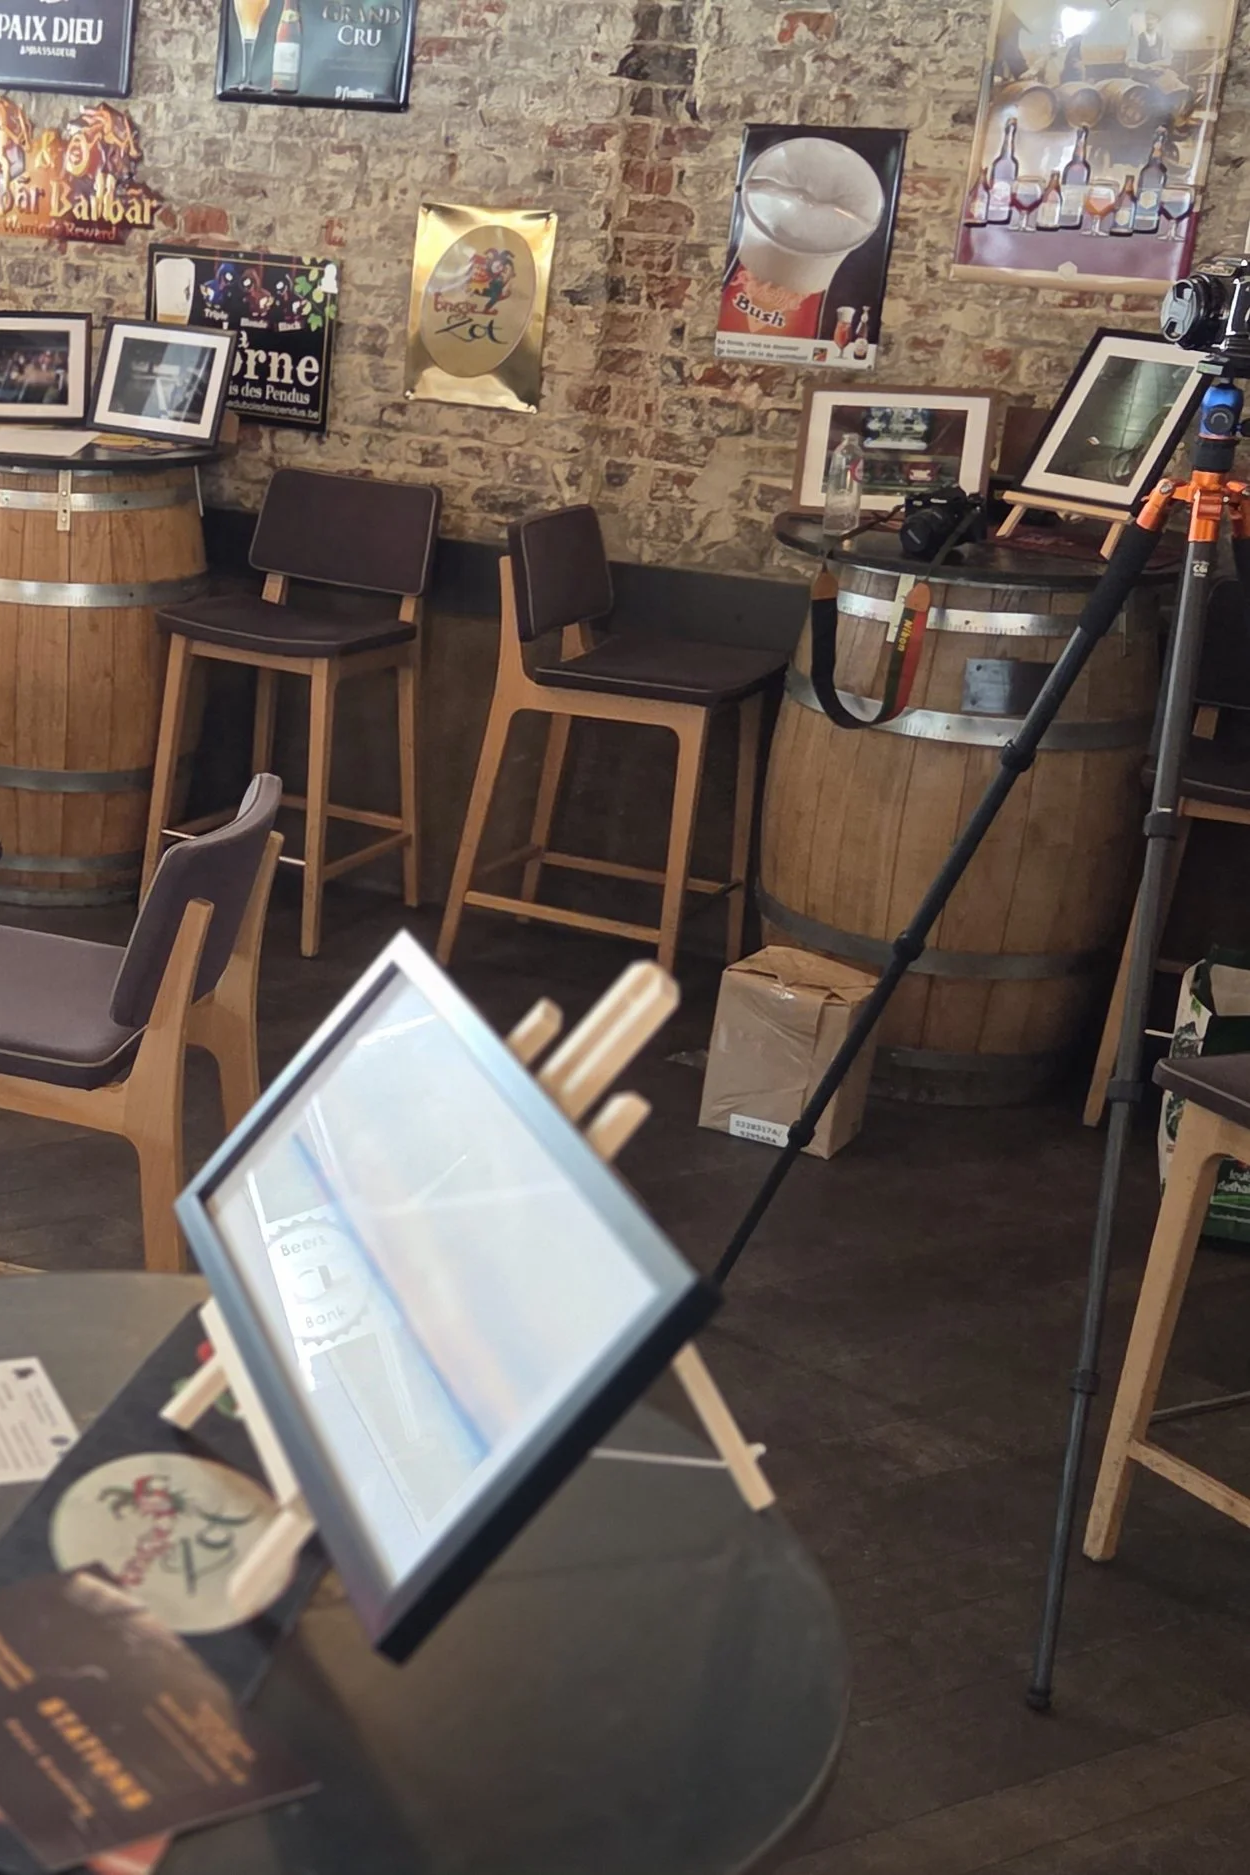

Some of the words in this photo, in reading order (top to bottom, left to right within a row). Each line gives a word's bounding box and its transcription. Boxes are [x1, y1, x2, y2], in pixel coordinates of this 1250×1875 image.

[322, 3, 401, 25] GRAND
[52, 17, 103, 45] DIEU
[337, 25, 382, 47] CRU
[732, 292, 786, 328] Bush
[240, 381, 263, 399] des
[265, 384, 311, 405] Pendus
[897, 619, 914, 652] Nikon
[279, 1233, 328, 1257] Beers
[304, 1305, 349, 1330] Bank
